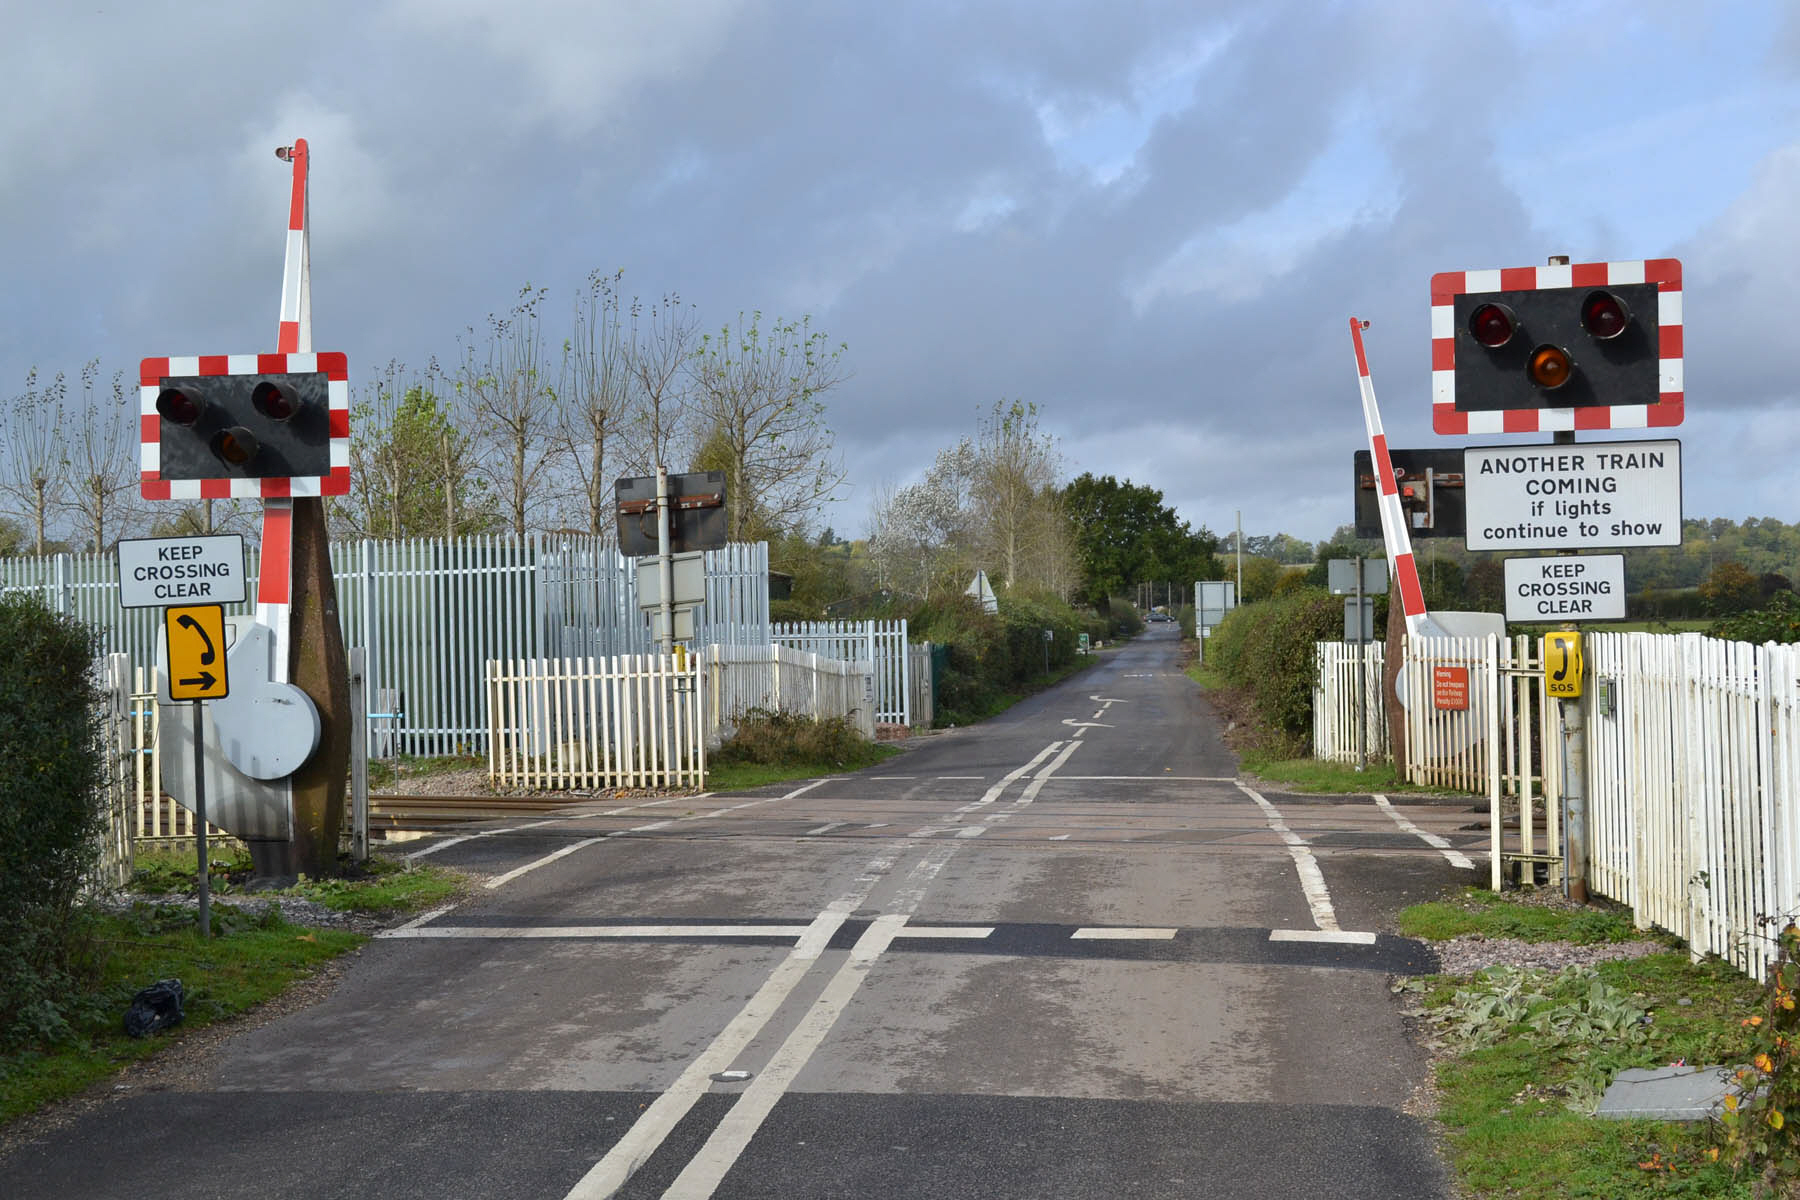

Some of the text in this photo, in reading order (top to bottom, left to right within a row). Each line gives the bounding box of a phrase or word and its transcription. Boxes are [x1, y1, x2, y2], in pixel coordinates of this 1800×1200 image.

[1480, 452, 1664, 474] ANOTHER TRAIN
[1526, 477, 1617, 495] COMING
[1531, 500, 1612, 519] if lights
[1483, 521, 1662, 540] continue to show
[158, 545, 203, 561] KEEP
[134, 563, 230, 581] CROSSING
[1542, 564, 1585, 578] KEEP
[154, 582, 211, 599] CLEAR
[1518, 581, 1611, 598] CROSSING
[1537, 600, 1592, 615] CLEAR
[1551, 683, 1574, 692] SOS
